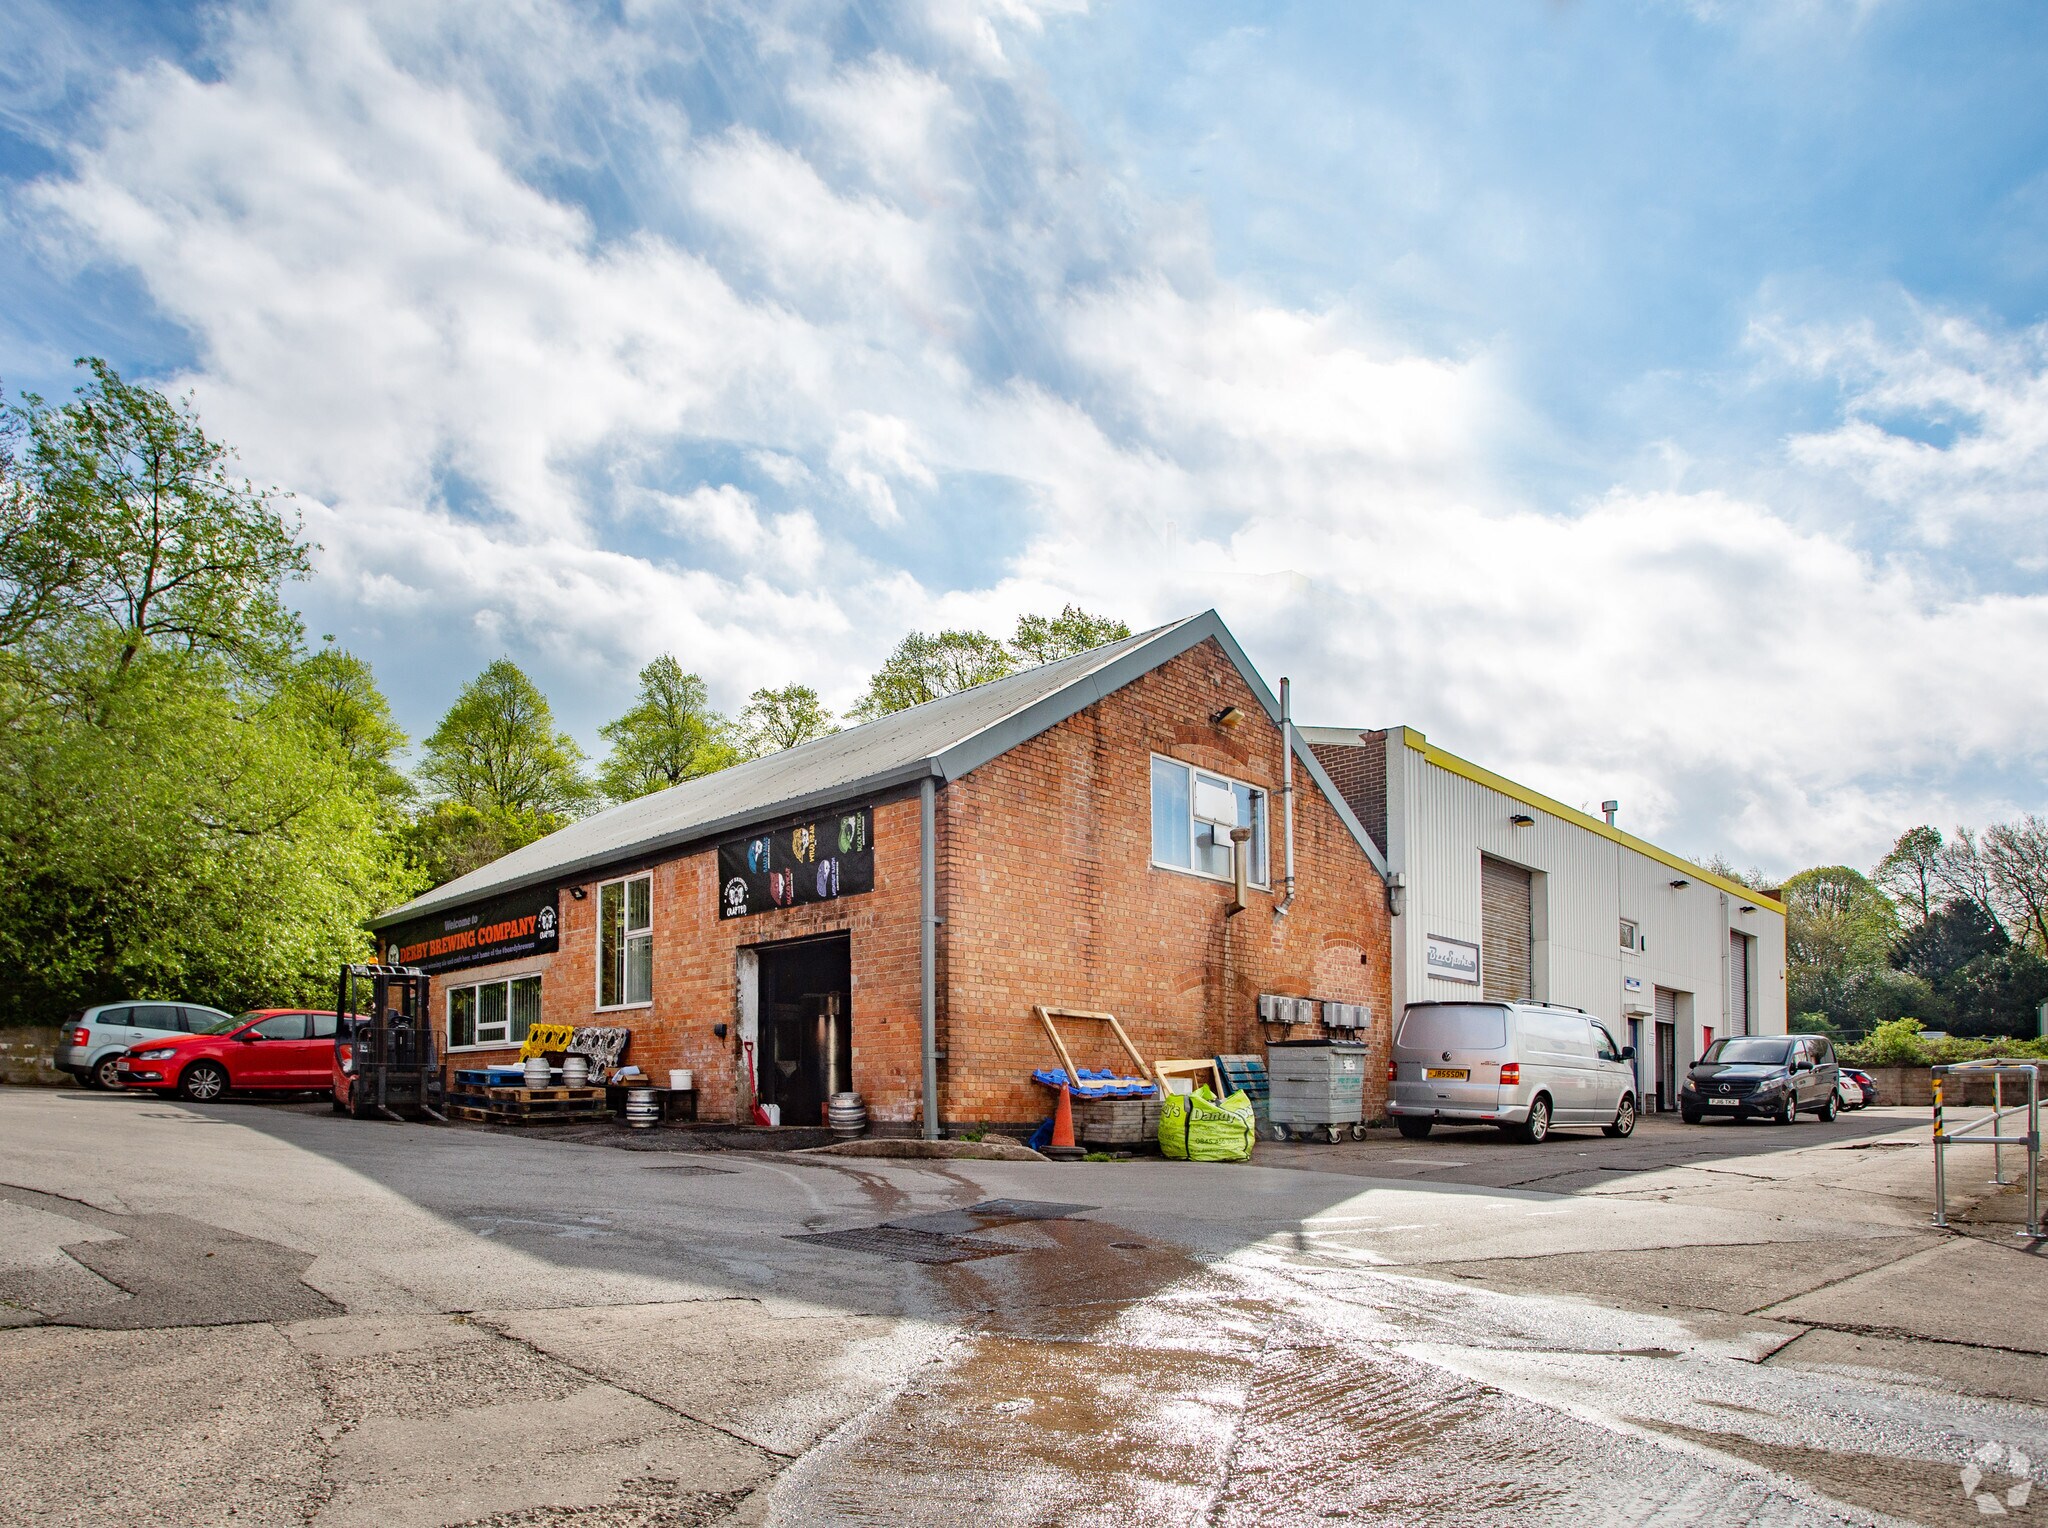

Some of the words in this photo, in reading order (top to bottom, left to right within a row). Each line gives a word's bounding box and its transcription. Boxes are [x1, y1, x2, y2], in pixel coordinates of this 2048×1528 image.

[727, 905, 747, 916] CRAFTED
[444, 918, 470, 931] Welcome
[471, 914, 478, 923] to
[400, 941, 429, 964] DERBY
[429, 930, 476, 956] BREWING
[478, 915, 537, 945] COMPANY
